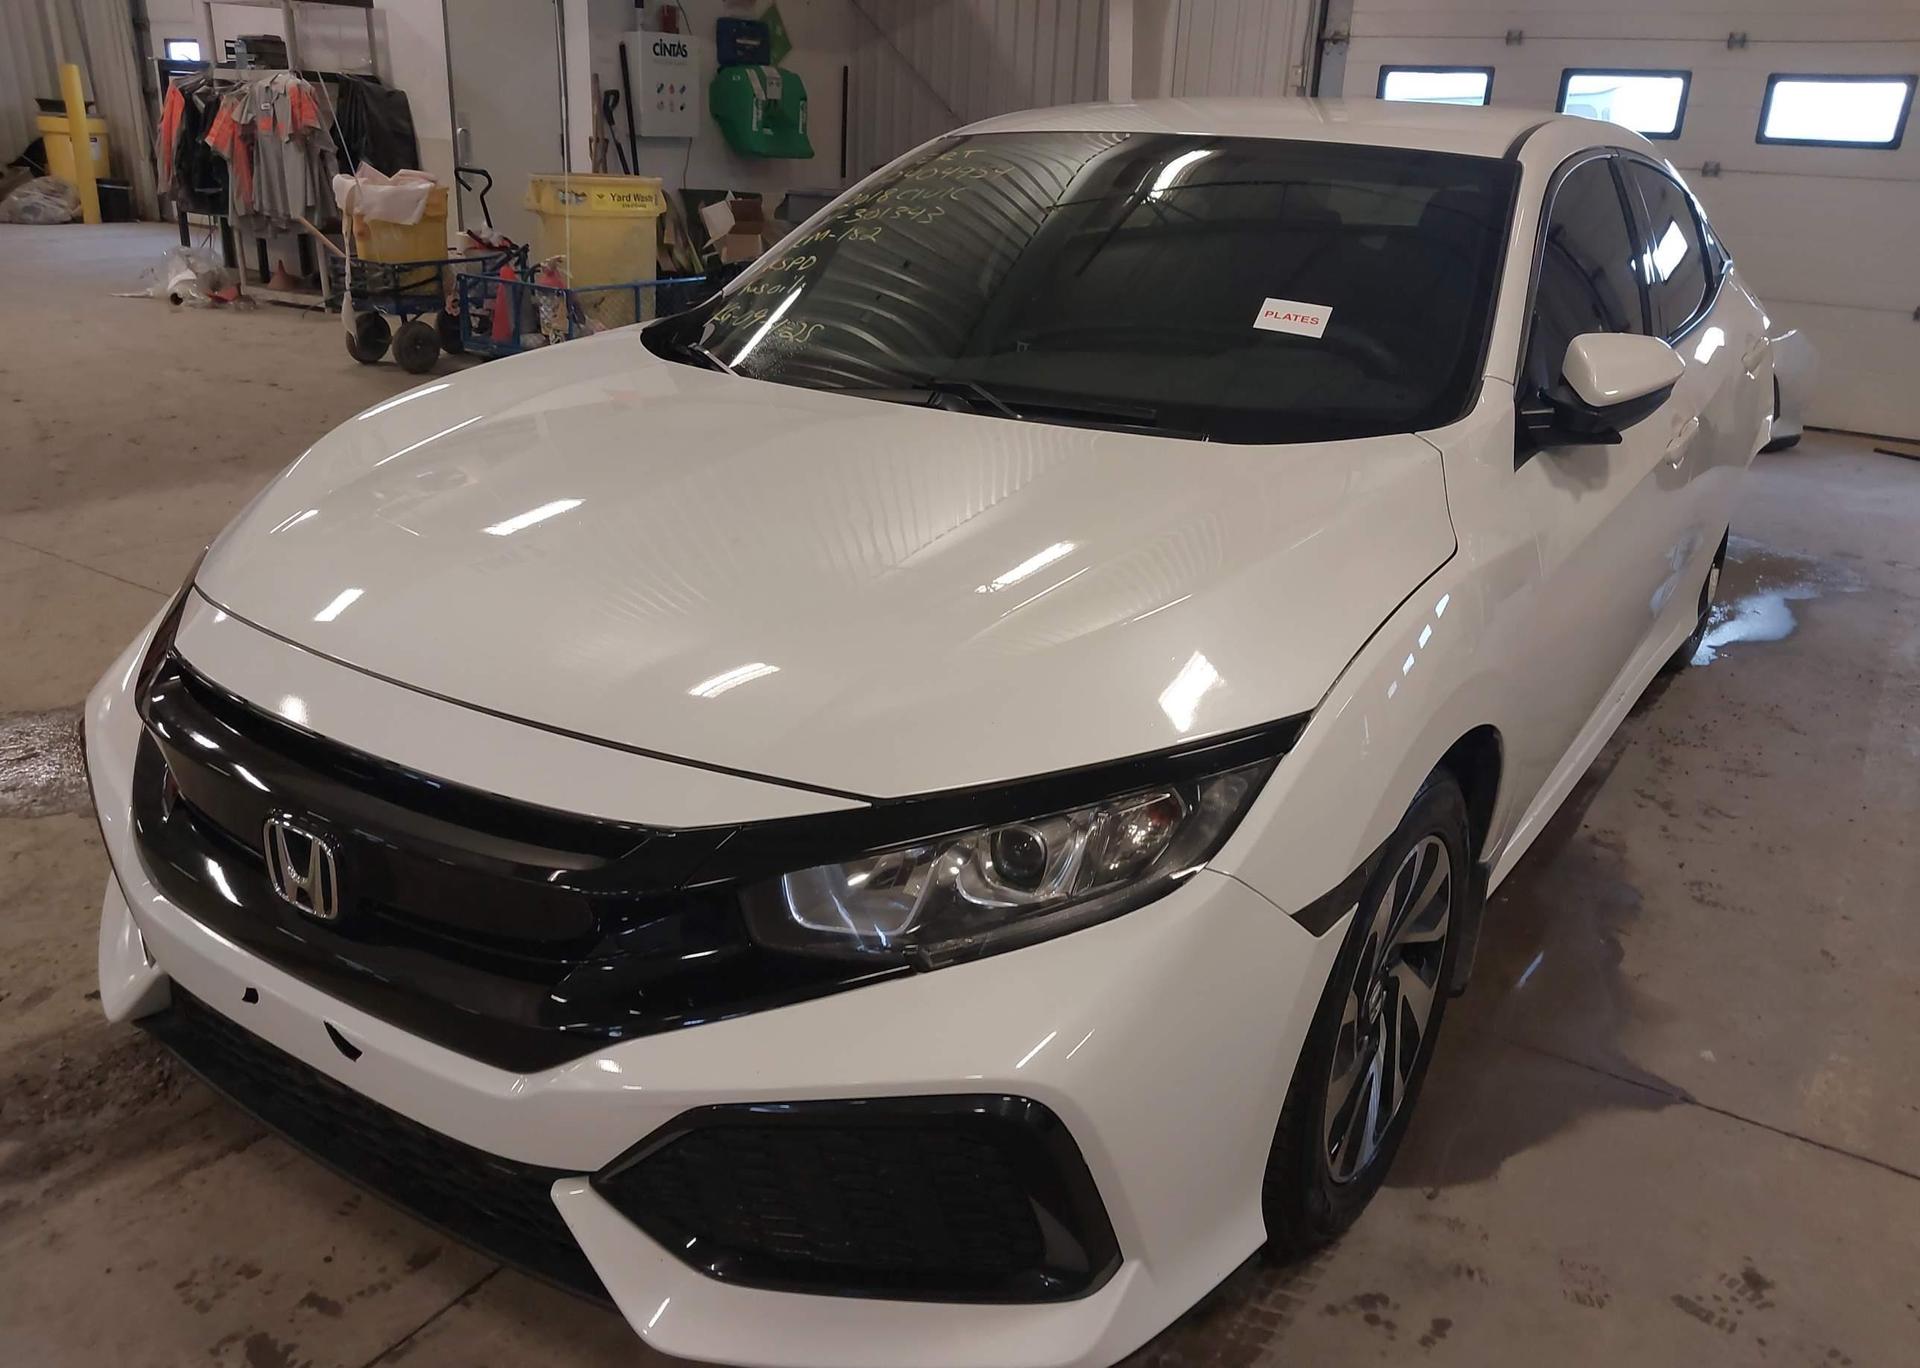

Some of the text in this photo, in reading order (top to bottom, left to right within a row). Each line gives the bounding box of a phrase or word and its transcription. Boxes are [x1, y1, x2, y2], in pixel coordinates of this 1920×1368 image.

[653, 38, 688, 57] CINTAS
[610, 192, 631, 202] Yard
[1264, 310, 1320, 326] PLATES
